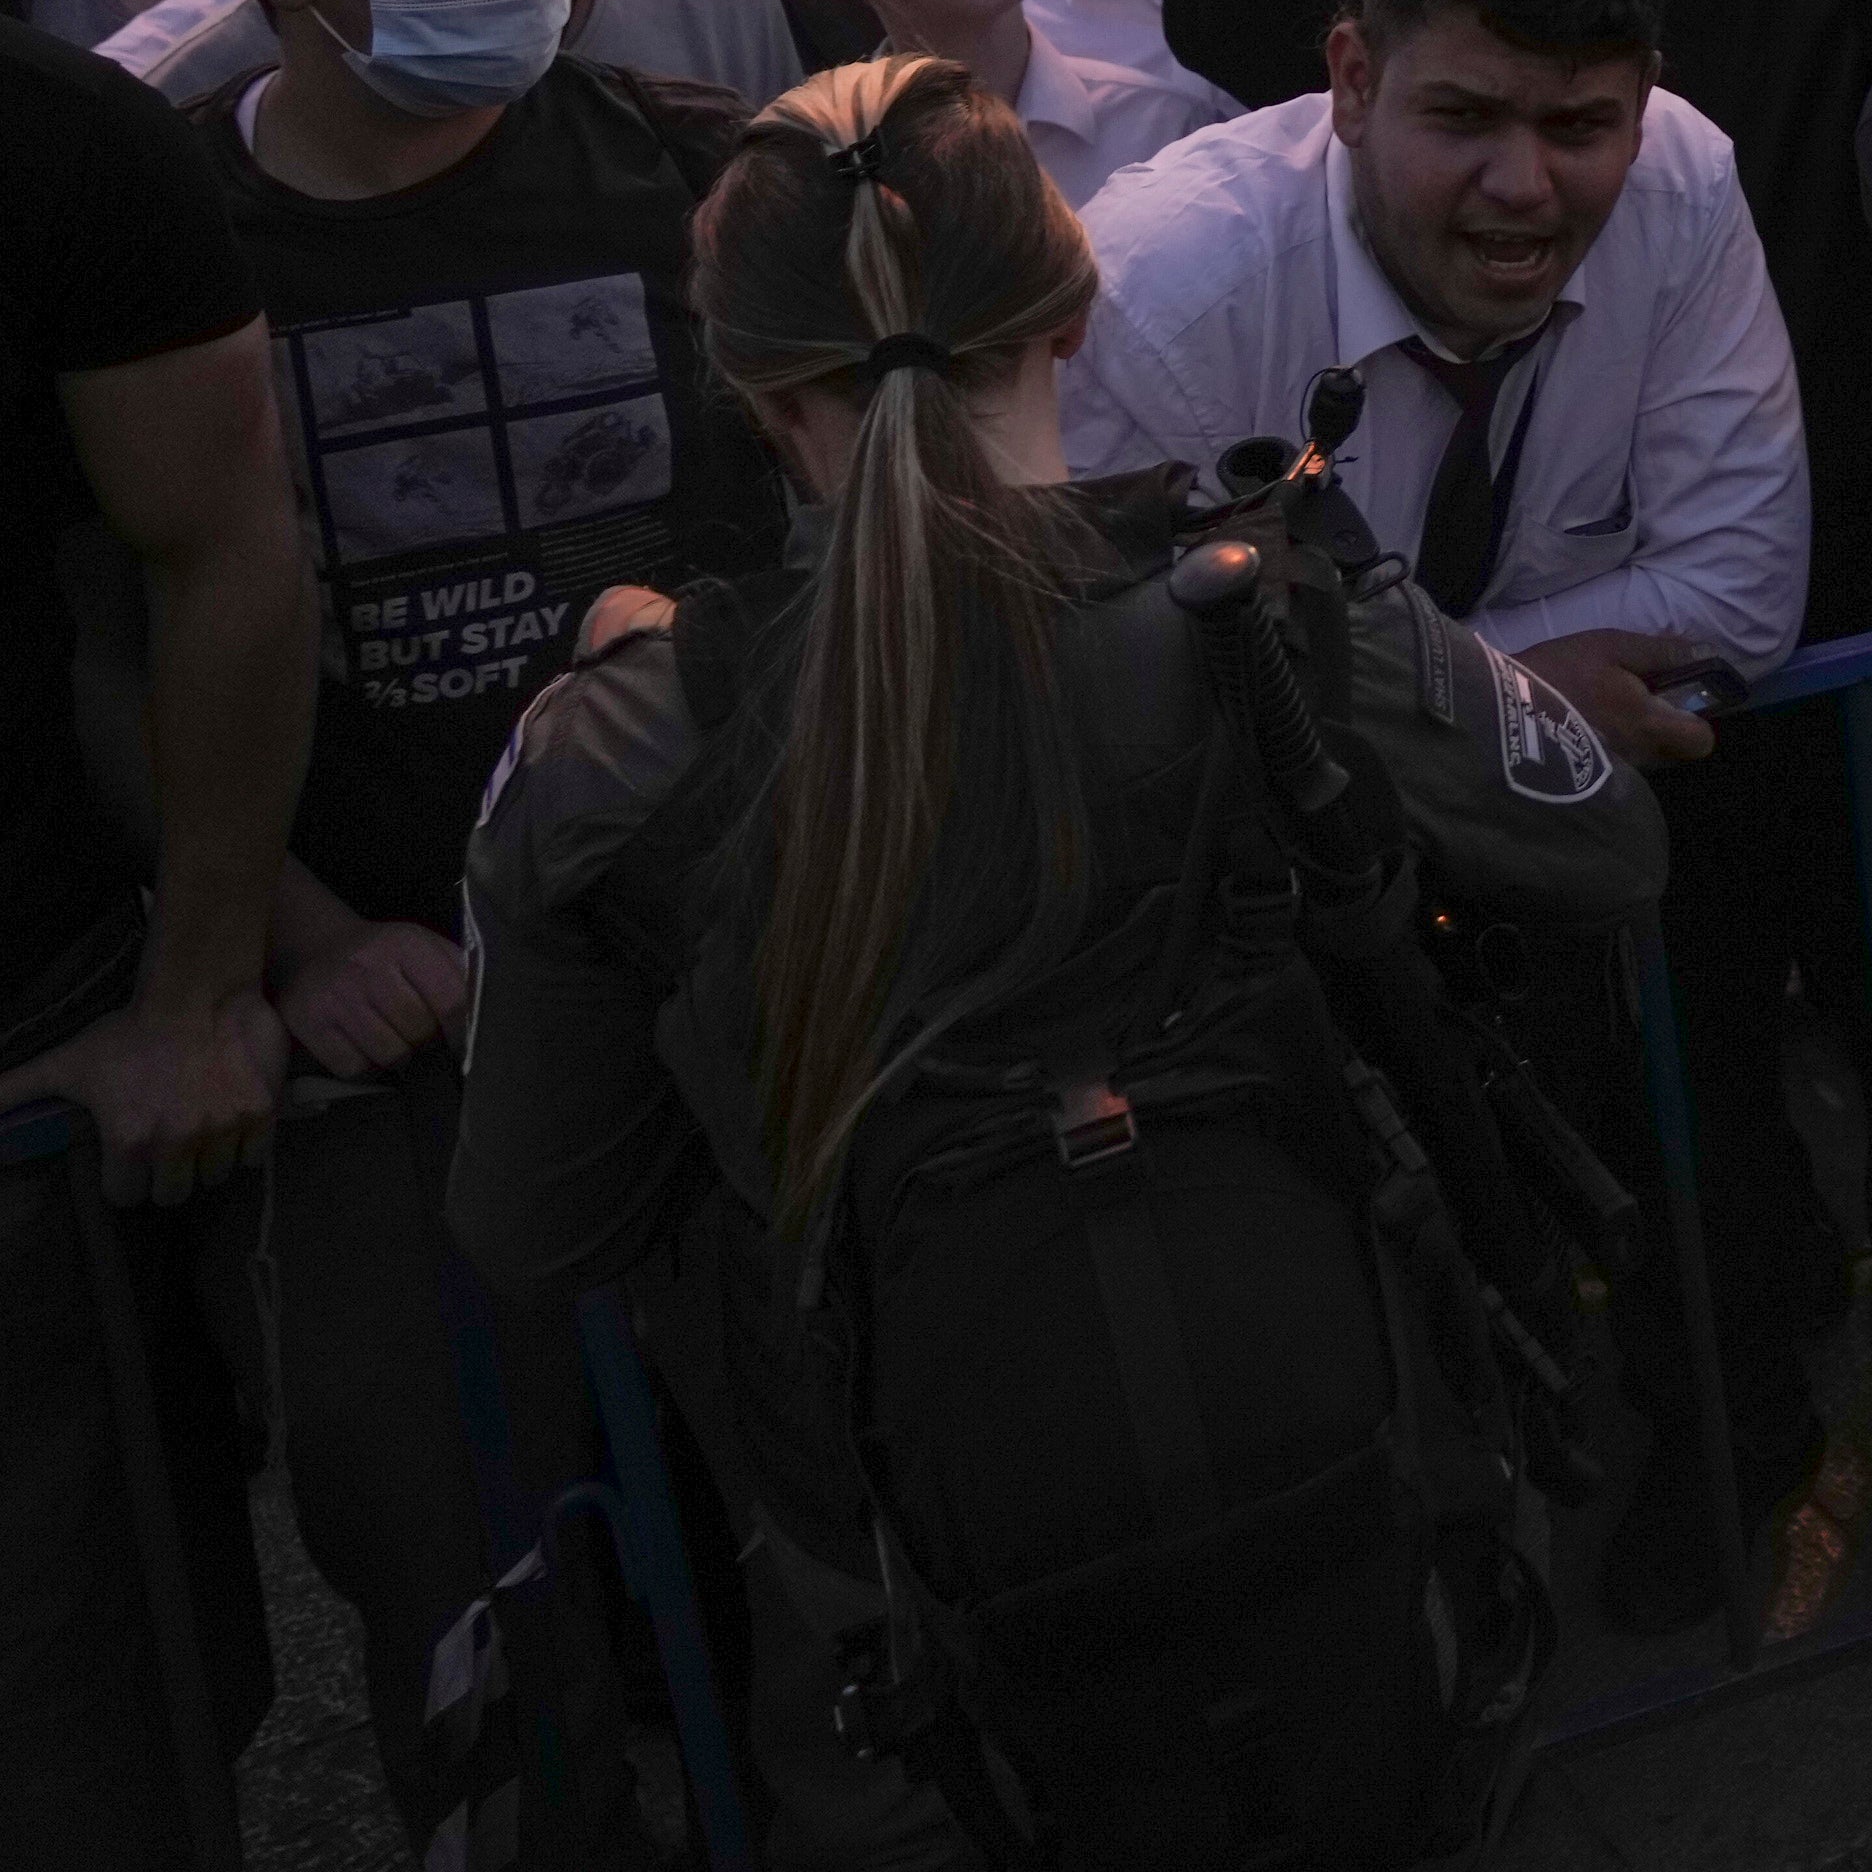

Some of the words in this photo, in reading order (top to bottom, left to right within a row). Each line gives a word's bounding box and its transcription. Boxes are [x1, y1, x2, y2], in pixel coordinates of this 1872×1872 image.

[351, 596, 409, 632] BE
[420, 571, 537, 621] WILD
[359, 629, 451, 671] BUT
[460, 602, 571, 654] STAY
[410, 655, 529, 704] SOFT
